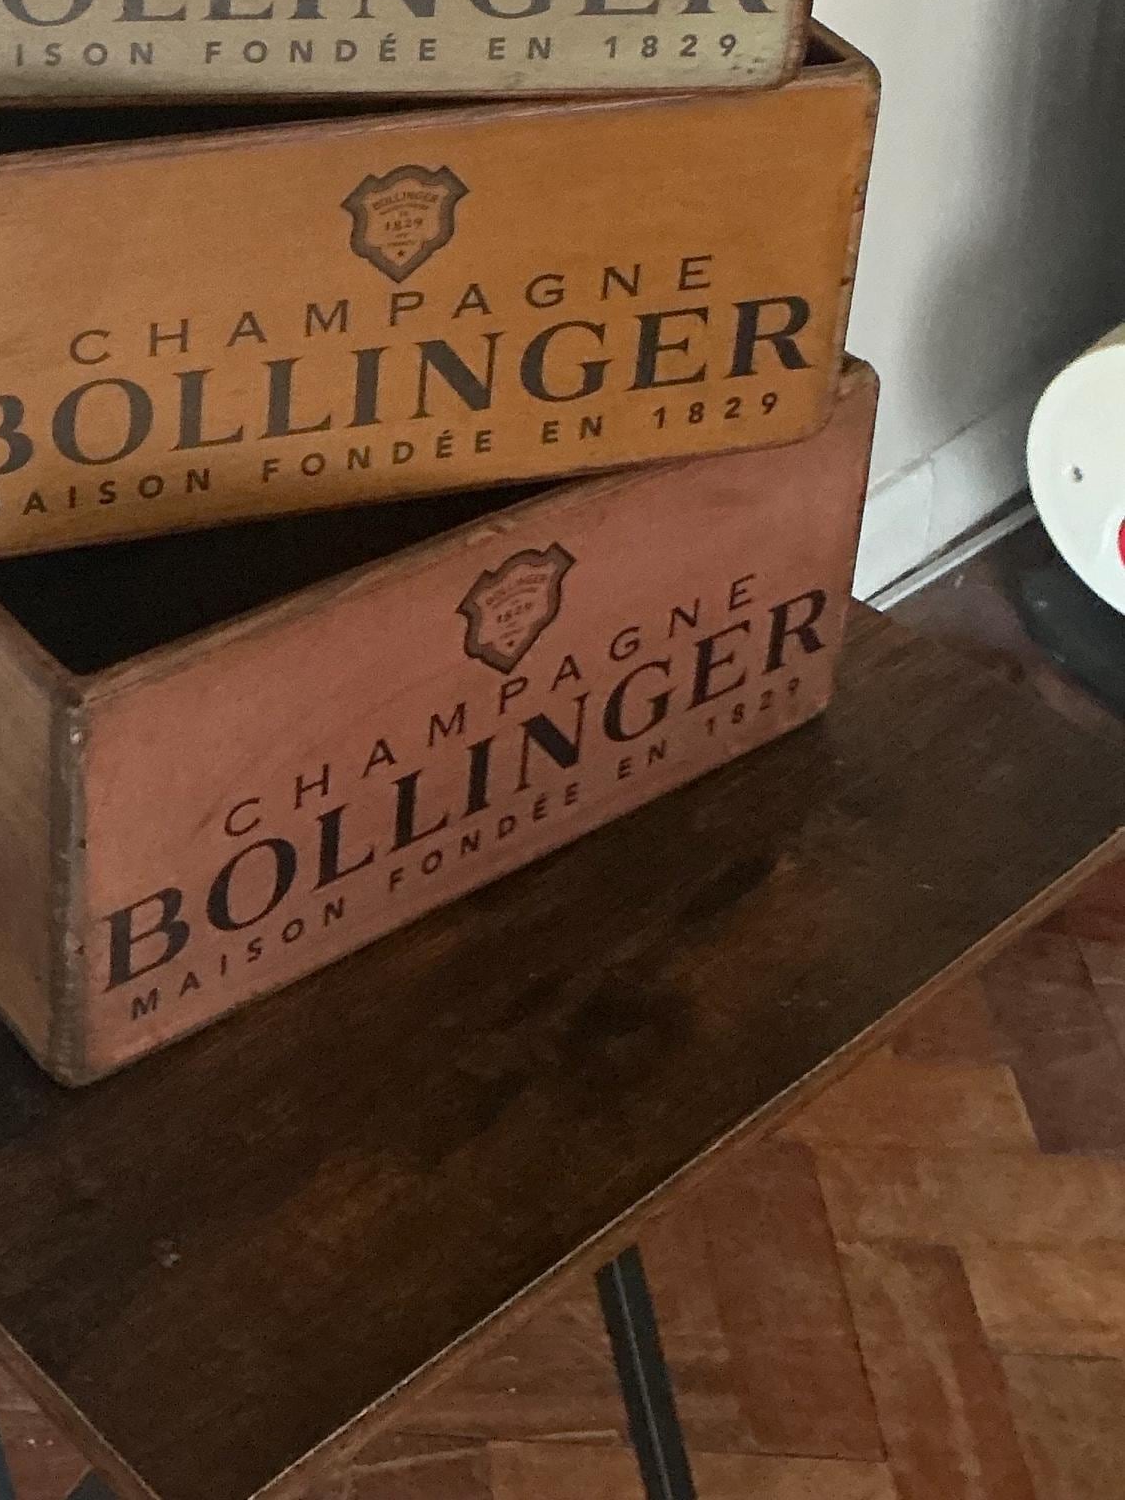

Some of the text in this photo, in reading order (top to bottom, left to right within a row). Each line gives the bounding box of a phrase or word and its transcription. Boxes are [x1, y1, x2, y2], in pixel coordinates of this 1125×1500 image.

[205, 33, 437, 64] FONDÉE
[489, 36, 552, 62] EN
[605, 33, 739, 59] 1829
[69, 255, 713, 366] CHAMPAGNE
[261, 430, 494, 484] FONDÉE
[542, 415, 604, 446] EN
[652, 392, 780, 431] 1829
[103, 589, 829, 993] BOLLINGER
[225, 573, 756, 838] CHAMPAGNE
[131, 677, 801, 1020] MAISON FONDÉE EN 1829
